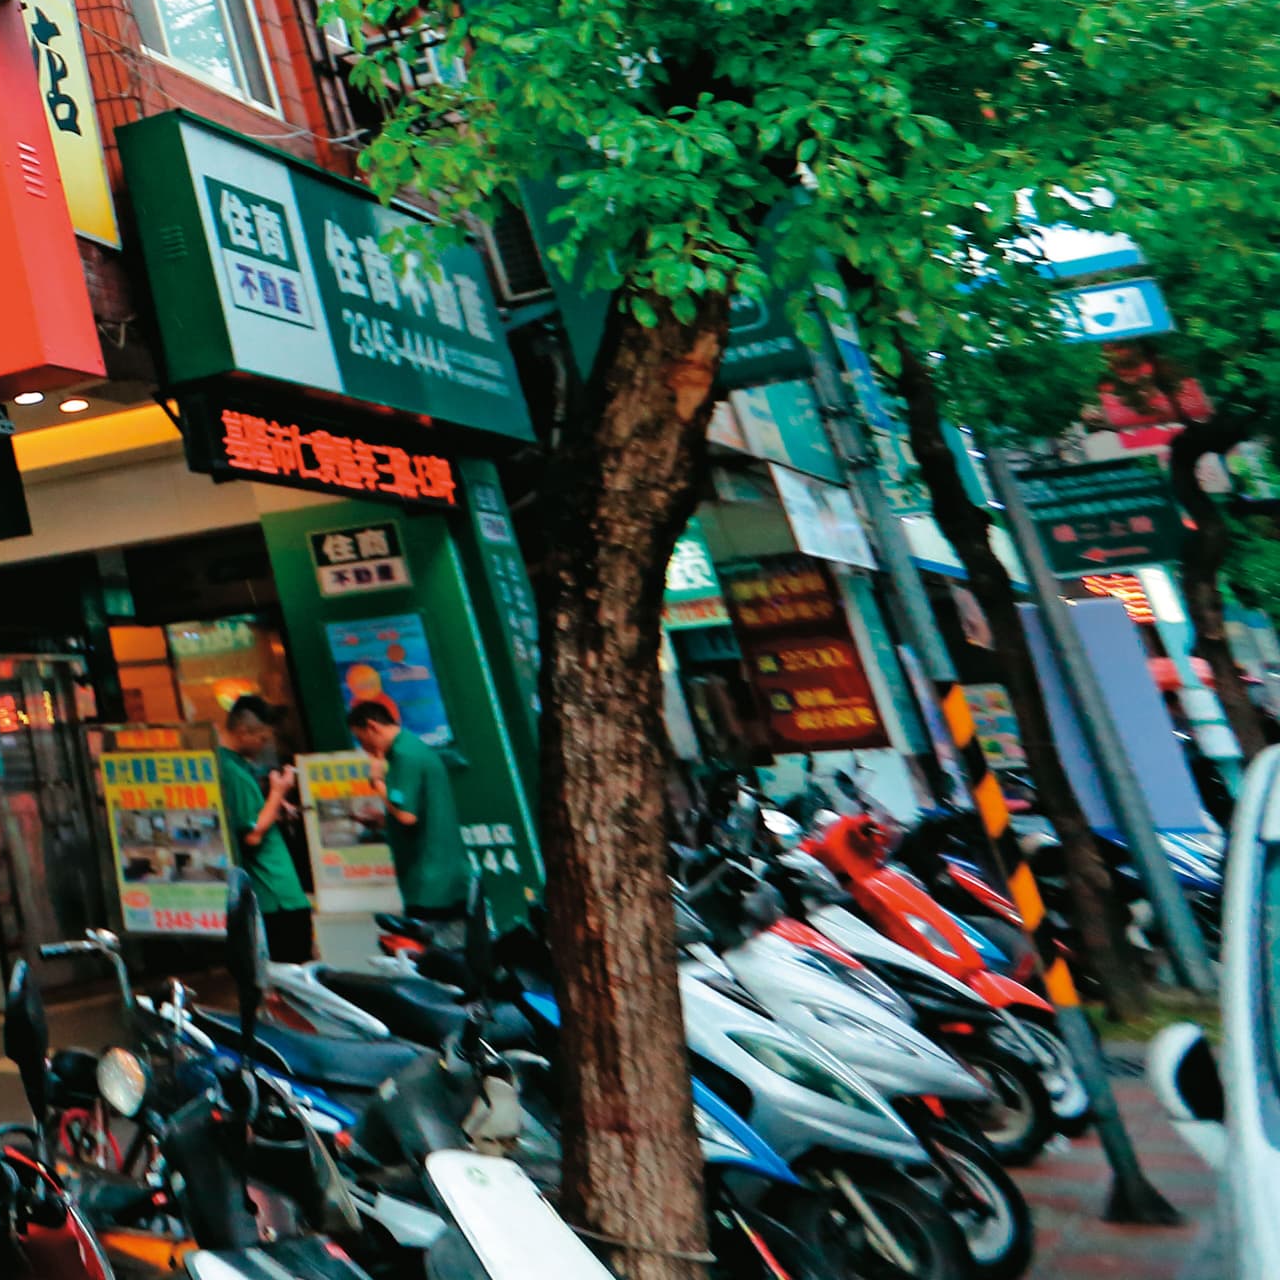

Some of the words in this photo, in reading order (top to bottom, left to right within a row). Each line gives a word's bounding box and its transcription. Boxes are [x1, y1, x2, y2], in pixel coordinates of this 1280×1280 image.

[218, 188, 290, 263] 住商
[234, 261, 304, 316] 不動產
